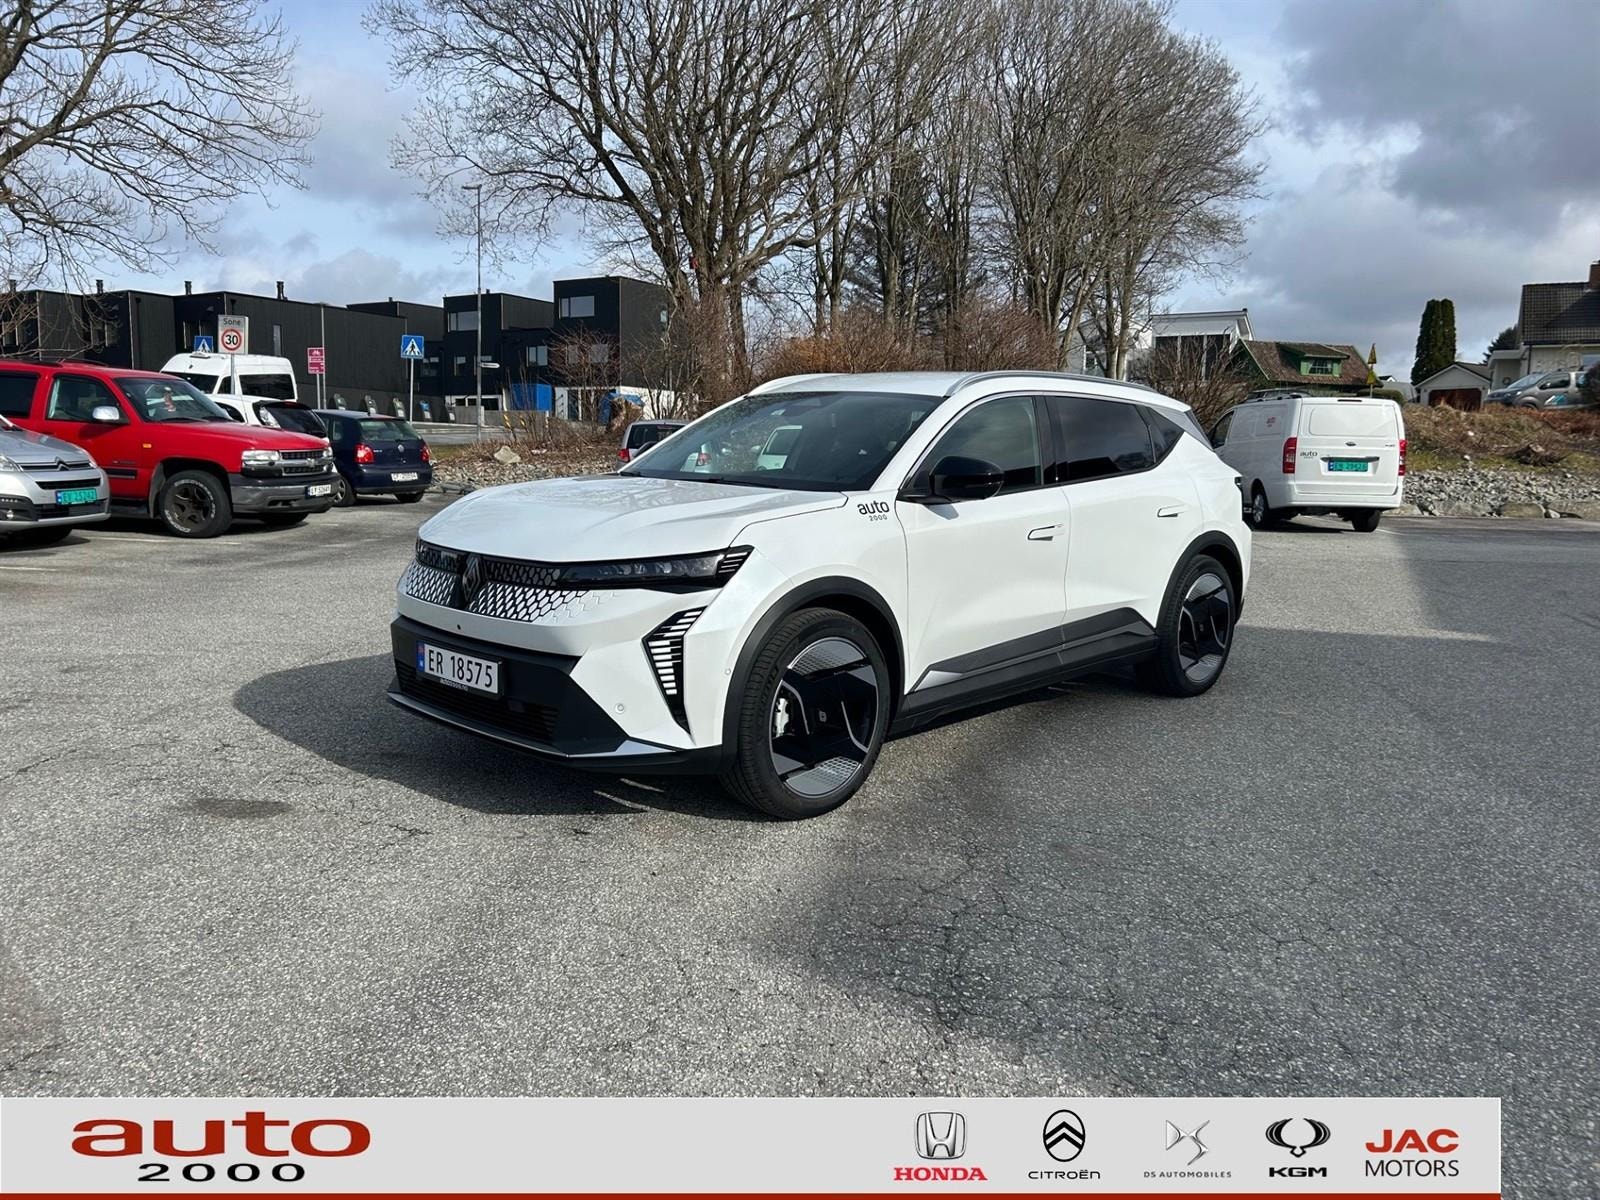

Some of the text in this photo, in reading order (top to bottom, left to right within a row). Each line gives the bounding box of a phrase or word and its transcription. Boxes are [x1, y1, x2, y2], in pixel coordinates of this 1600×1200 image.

[225, 334, 239, 346] 30
[857, 500, 890, 515] auto
[428, 649, 444, 674] ER
[450, 655, 493, 688] 18575
